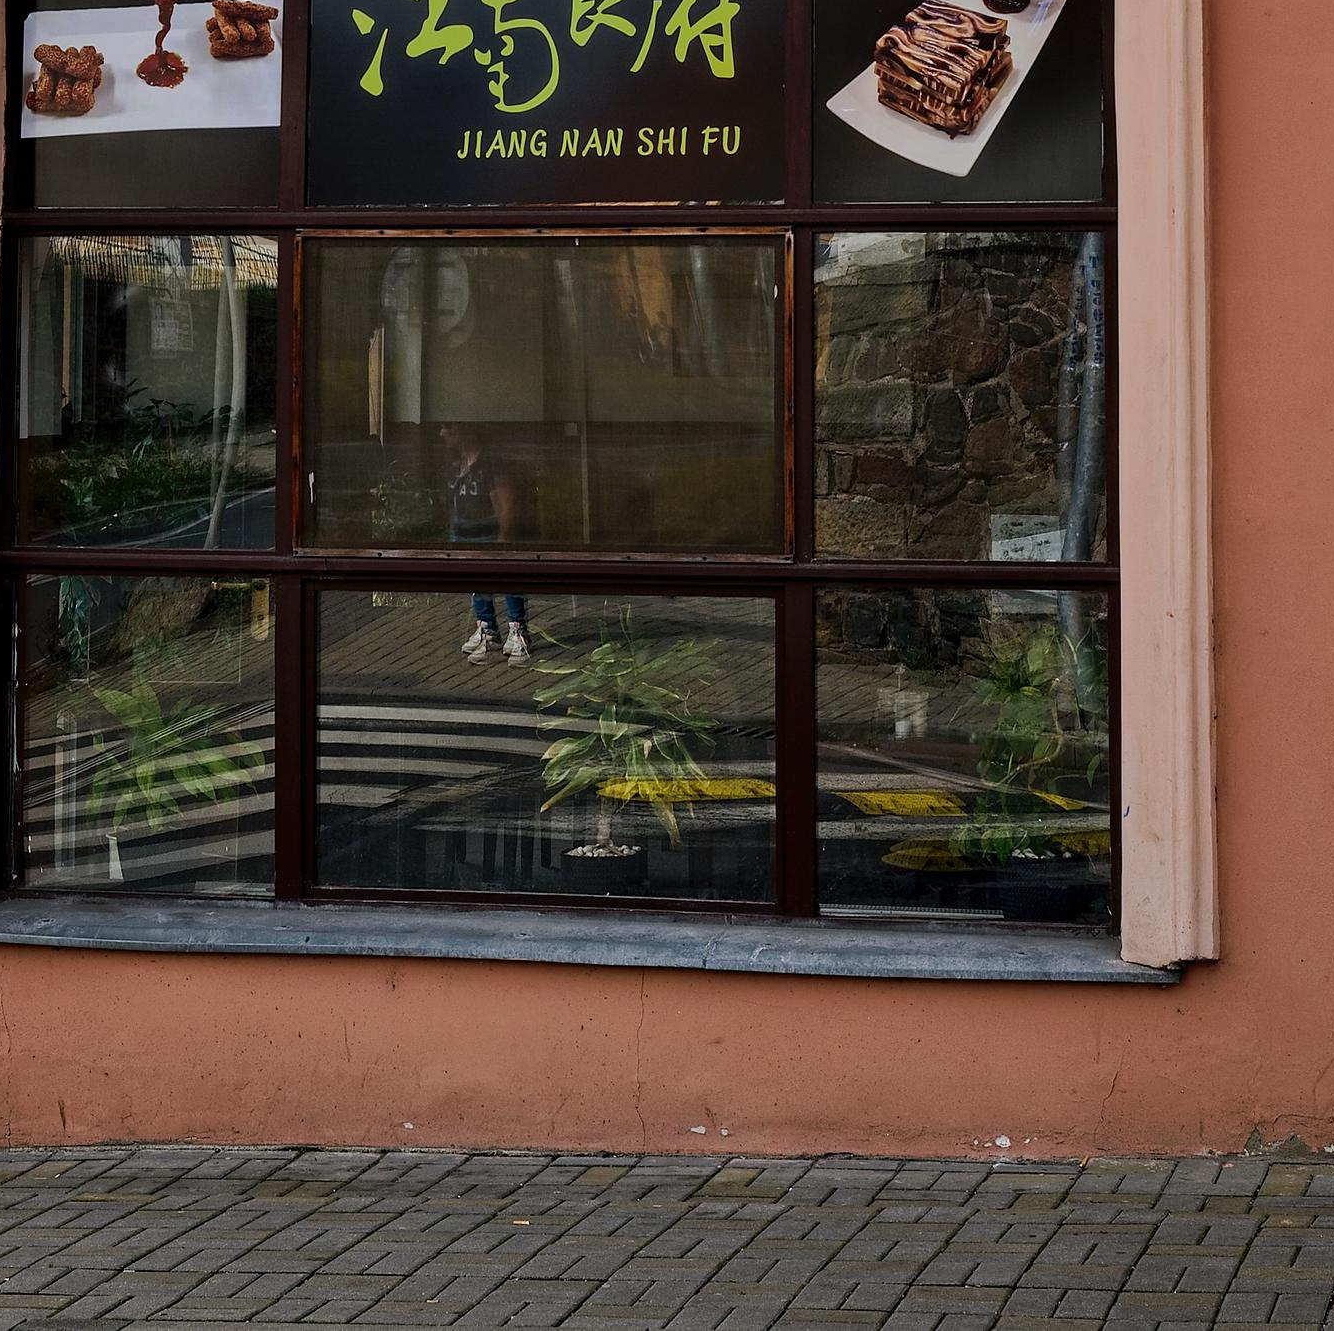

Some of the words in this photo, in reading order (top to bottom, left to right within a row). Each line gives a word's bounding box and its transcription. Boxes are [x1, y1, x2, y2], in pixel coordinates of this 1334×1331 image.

[457, 129, 547, 159] JIANG
[559, 127, 624, 157] NAN
[637, 126, 688, 156] SHI
[702, 125, 741, 156] FU
